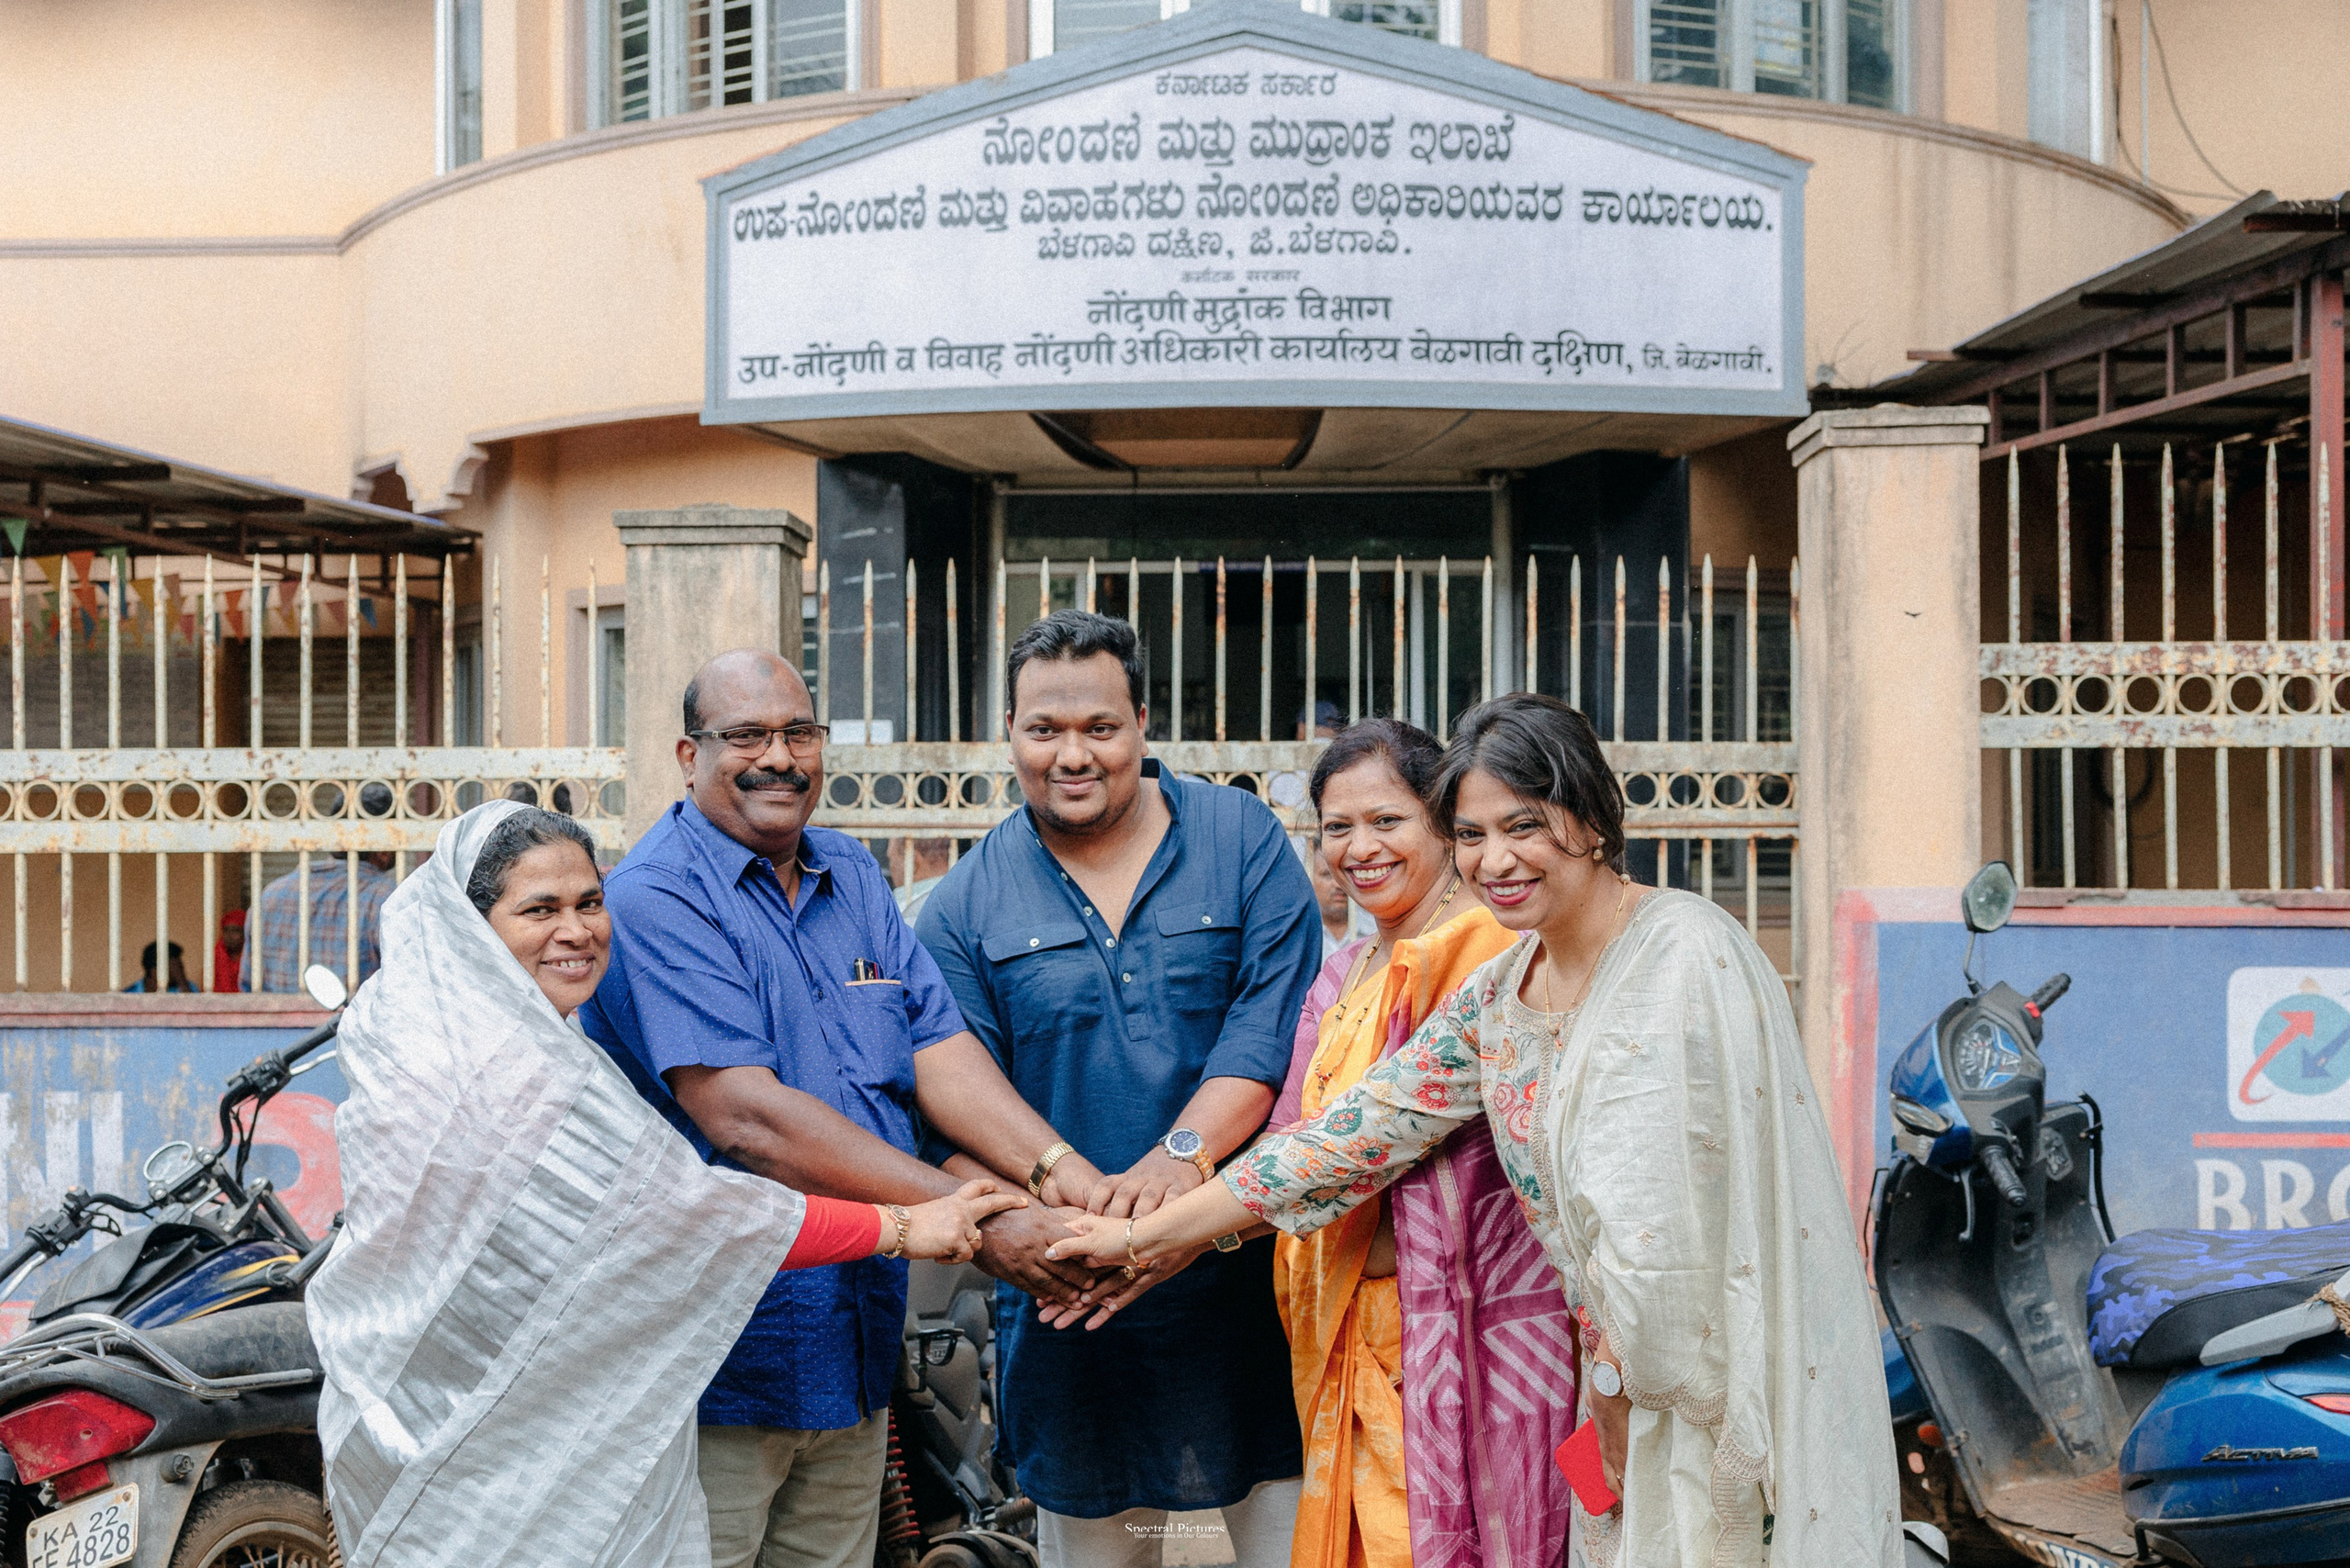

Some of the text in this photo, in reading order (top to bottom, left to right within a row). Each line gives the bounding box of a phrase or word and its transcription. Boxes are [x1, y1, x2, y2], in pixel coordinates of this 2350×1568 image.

[1156, 72, 1337, 96] ಕರ್ನಾಟಕ ಸರ್ಕಾರ
[1158, 117, 1236, 167] ಮತ್ತು
[1248, 114, 1395, 166] ಮುದ್ರಾಂಕ
[1408, 112, 1515, 165] ಇಲಾಖೆ
[938, 186, 1008, 232] ಮತ್ತು
[1020, 180, 1185, 223] ವಿವಾಹಗಳು
[1351, 180, 1563, 225] ಅಧಿಕಾರಿಯವರ
[1038, 227, 1136, 260] ಬೆಳಗಾವಿ
[1086, 286, 1393, 334] नोंदणी मुद्रांक विभाग
[895, 347, 917, 372] व
[923, 337, 1006, 379] विवाह
[1014, 332, 1115, 375] नोंदणी
[1121, 329, 1263, 366] अधिकारी
[1270, 329, 1401, 364] कार्यालय
[43, 1506, 118, 1551] KA 22
[66, 1523, 130, 1568] 4828
